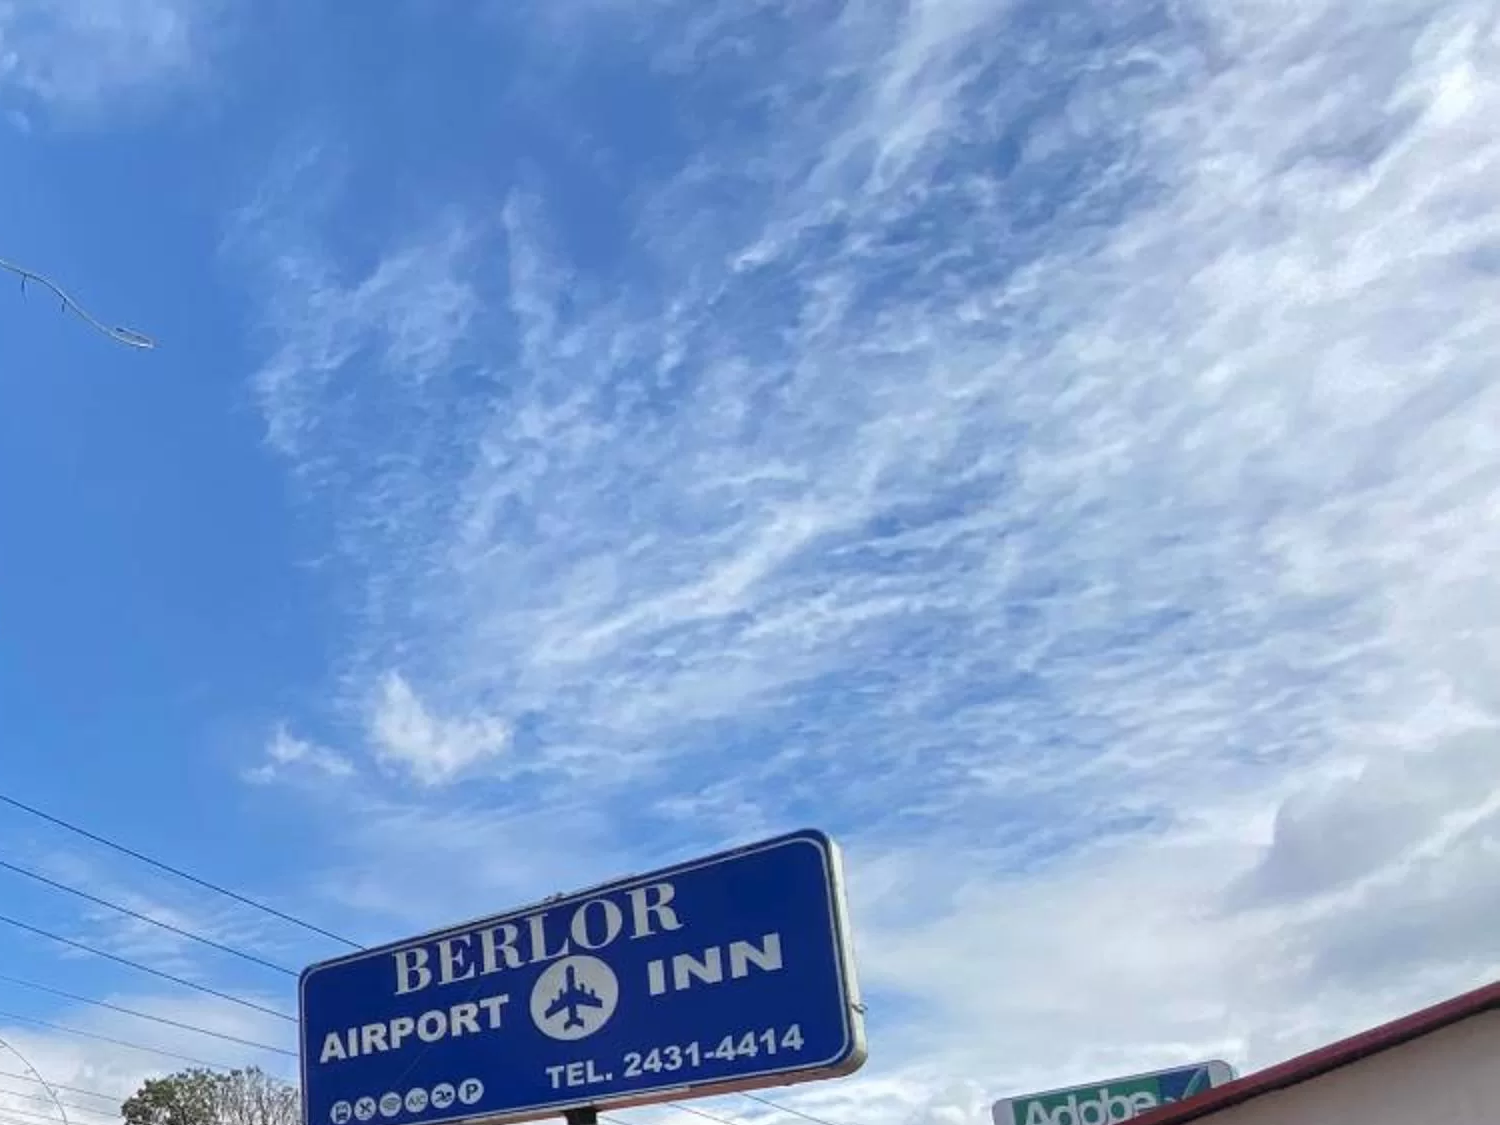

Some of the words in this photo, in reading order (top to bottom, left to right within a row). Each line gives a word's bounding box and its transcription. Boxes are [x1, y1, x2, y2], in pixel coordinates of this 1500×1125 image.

[391, 882, 683, 995] BERLOR
[320, 994, 509, 1063] AIRPORT
[647, 932, 783, 996] INN
[465, 1083, 479, 1100] P
[545, 1060, 613, 1089] TEL.
[623, 1024, 804, 1078] 2431-4414
